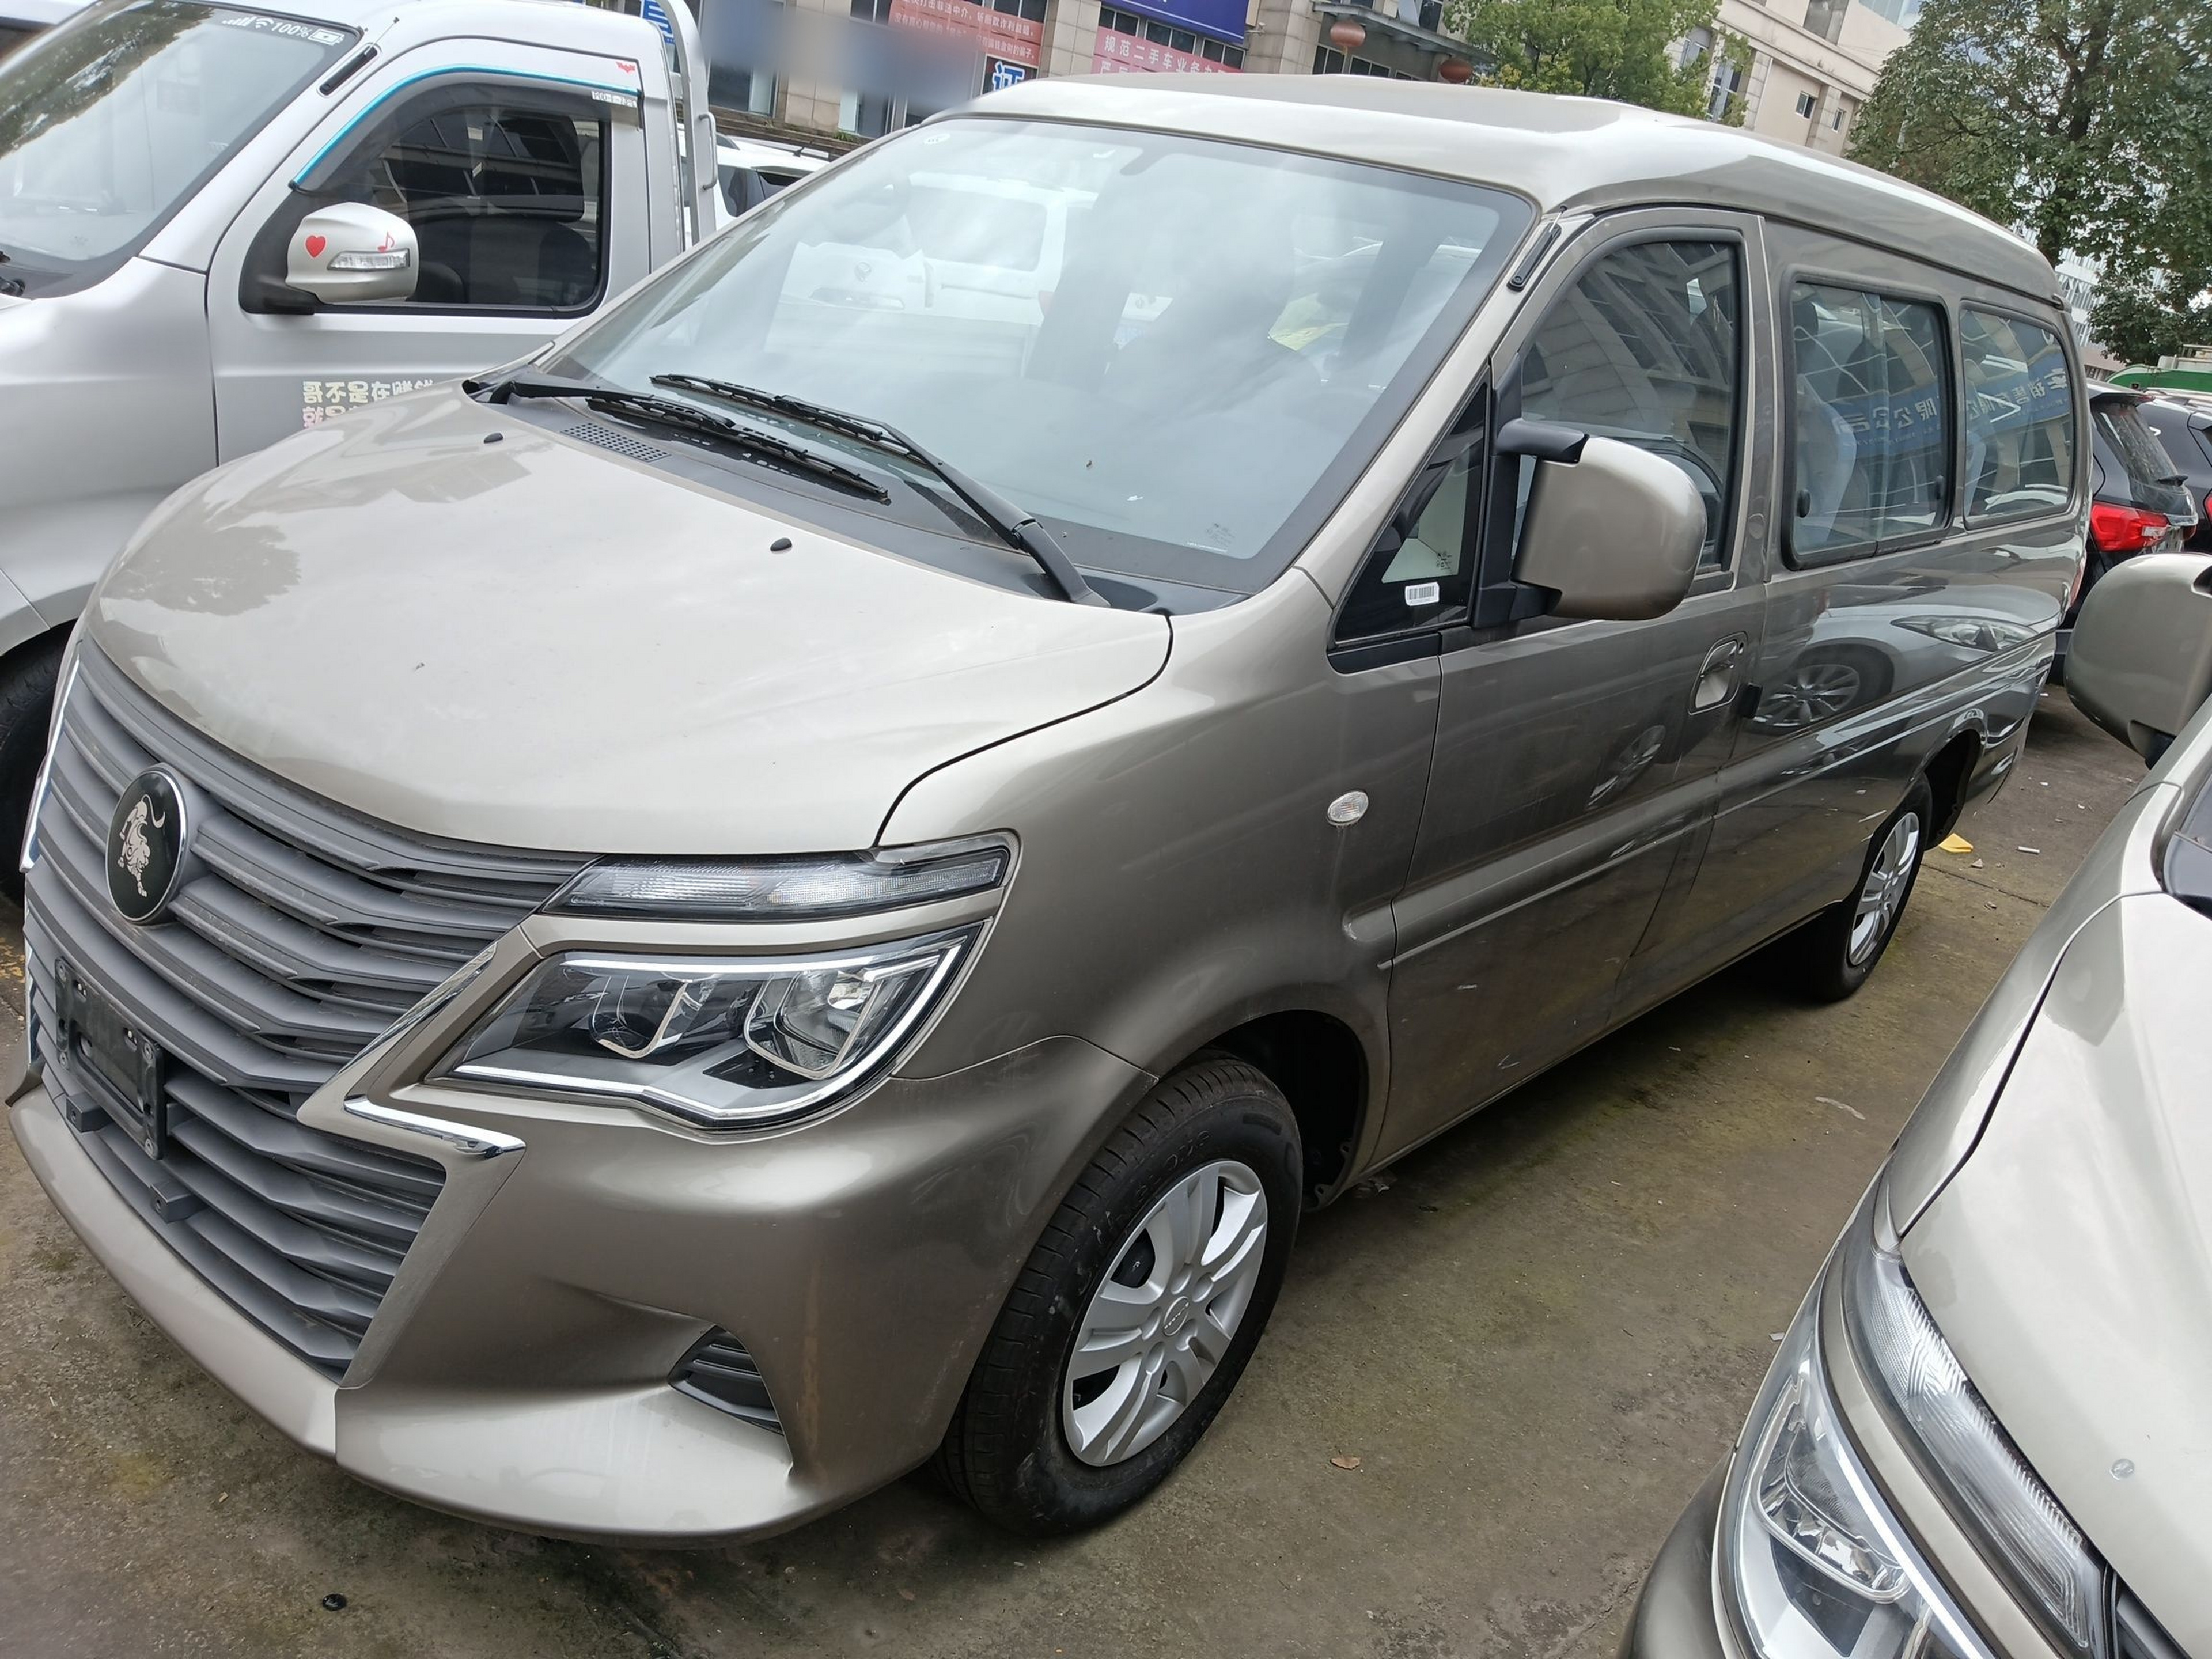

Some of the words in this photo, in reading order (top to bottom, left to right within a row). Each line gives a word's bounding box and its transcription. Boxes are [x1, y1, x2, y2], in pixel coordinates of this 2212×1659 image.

[271, 22, 312, 38] 100%
[1104, 34, 1226, 73] 规范二手车业务
